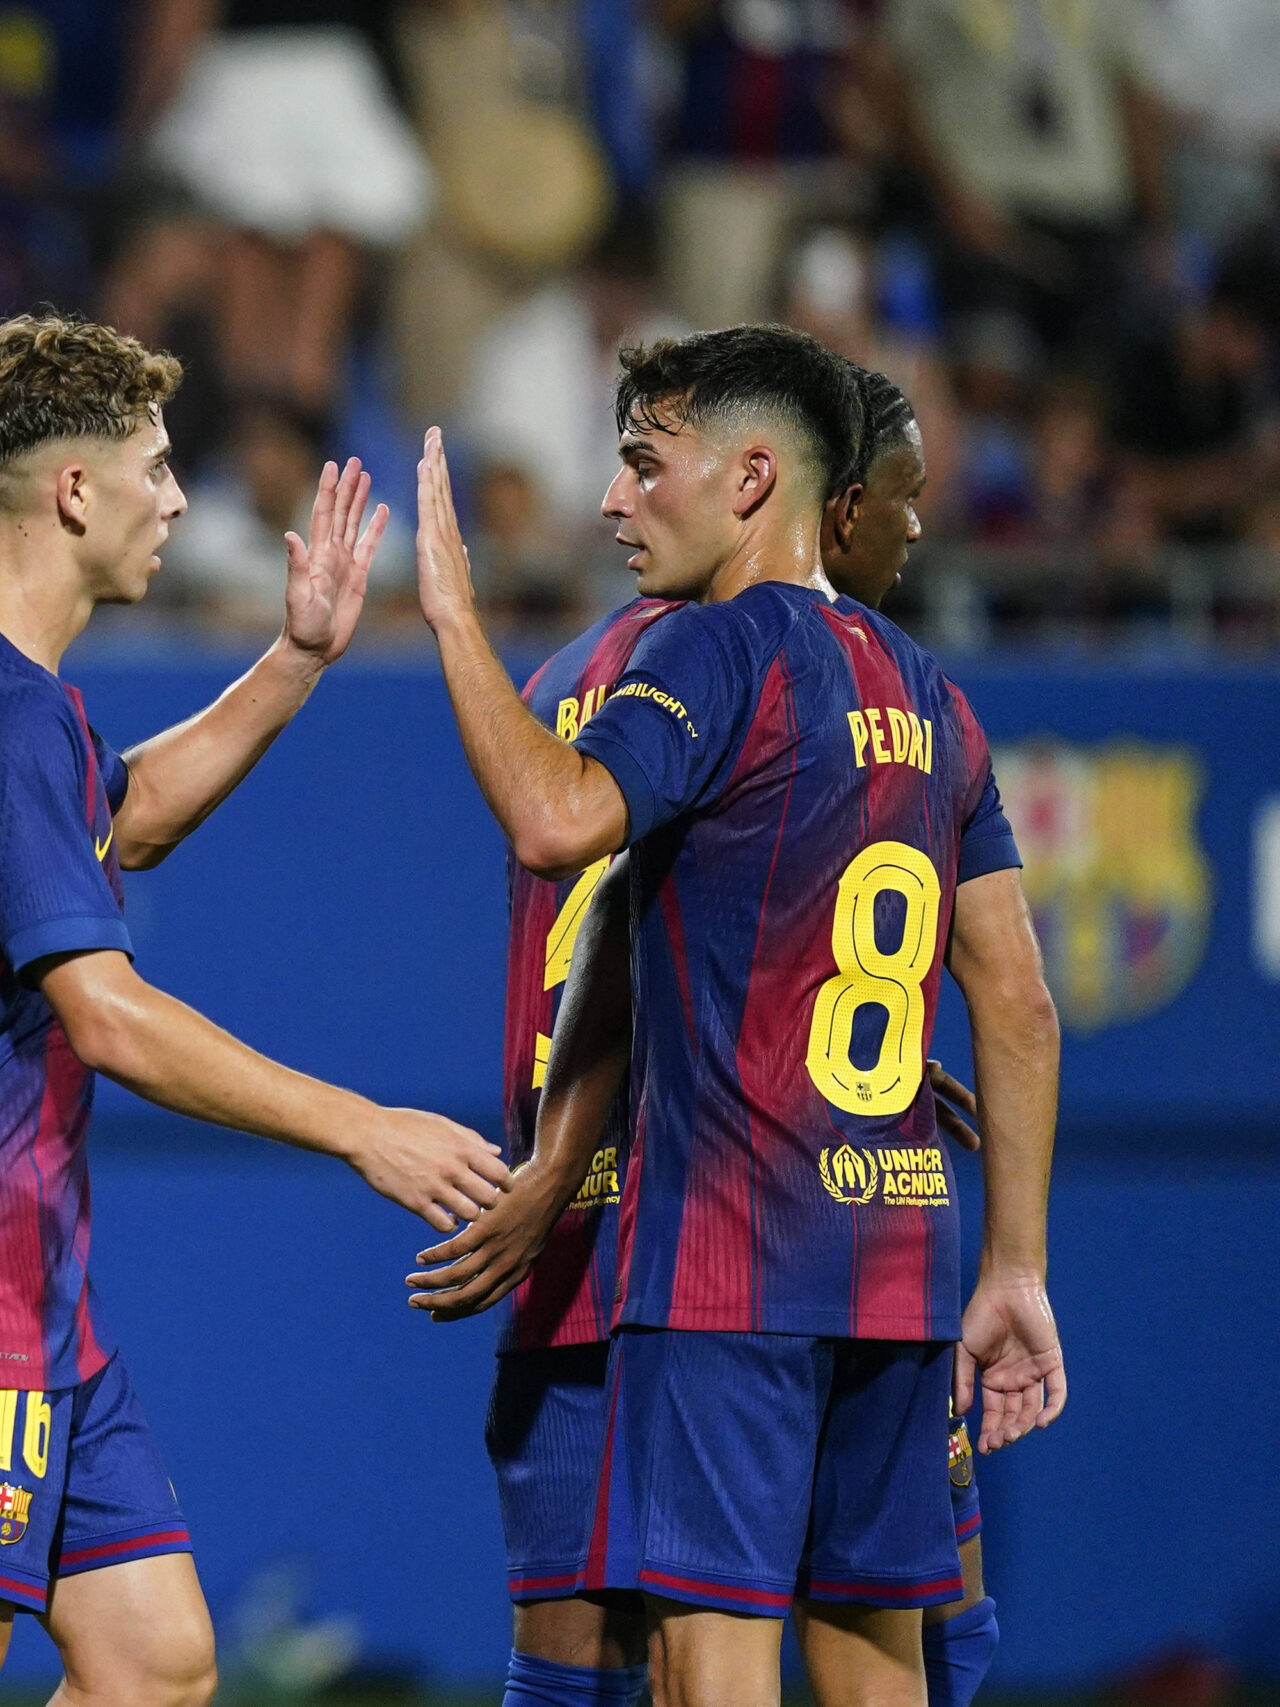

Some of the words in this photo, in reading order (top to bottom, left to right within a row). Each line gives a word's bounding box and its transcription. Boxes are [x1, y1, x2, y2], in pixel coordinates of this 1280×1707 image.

[612, 682, 687, 719] MBILIGHT
[846, 707, 933, 775] PEDRI
[804, 840, 942, 1117] 8
[877, 1148, 944, 1172] UNHCR
[882, 1172, 948, 1196] ACNUR
